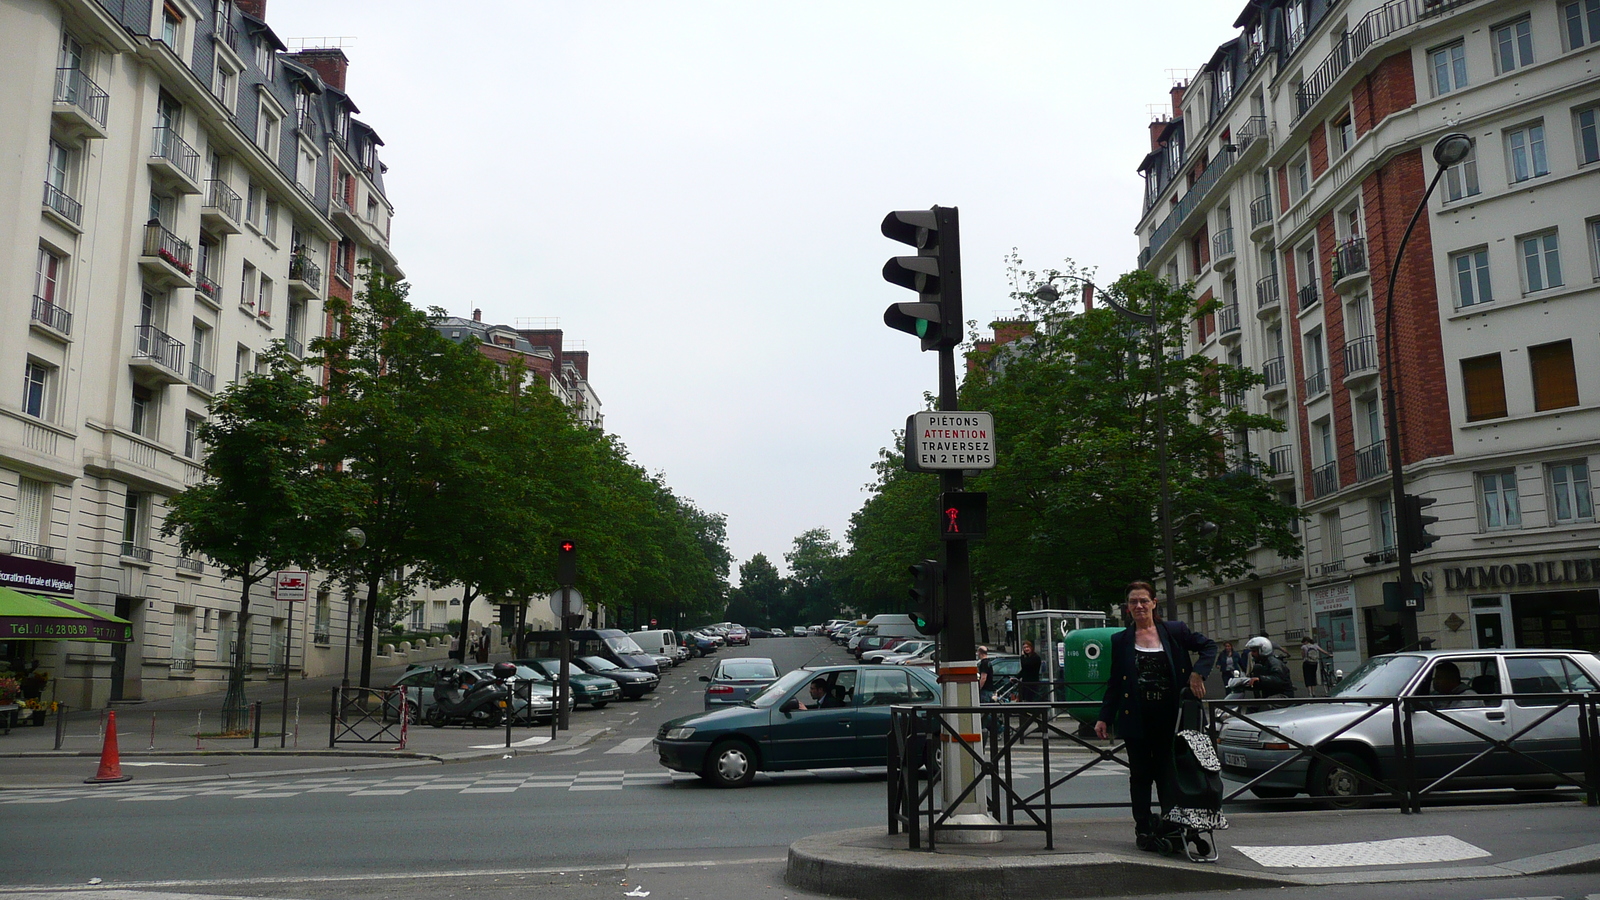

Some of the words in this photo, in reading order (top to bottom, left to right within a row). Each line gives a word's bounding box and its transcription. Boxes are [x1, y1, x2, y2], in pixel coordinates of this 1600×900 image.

[929, 415, 979, 426] PIÉTONS
[924, 429, 986, 439] ATTENTION
[922, 442, 989, 451] TRAVERSEZ
[922, 454, 937, 463] EN
[940, 454, 948, 463] 2
[952, 454, 991, 464] TEMPS
[25, 574, 44, 586] Florale
[45, 578, 51, 587] et
[52, 578, 74, 591] Végétale
[10, 623, 33, 635] Tél.
[34, 625, 43, 634] 01
[44, 625, 54, 635] 46
[56, 625, 66, 635] 28
[68, 625, 77, 635] 08
[78, 625, 88, 635] 89
[106, 628, 117, 638] 7/7
